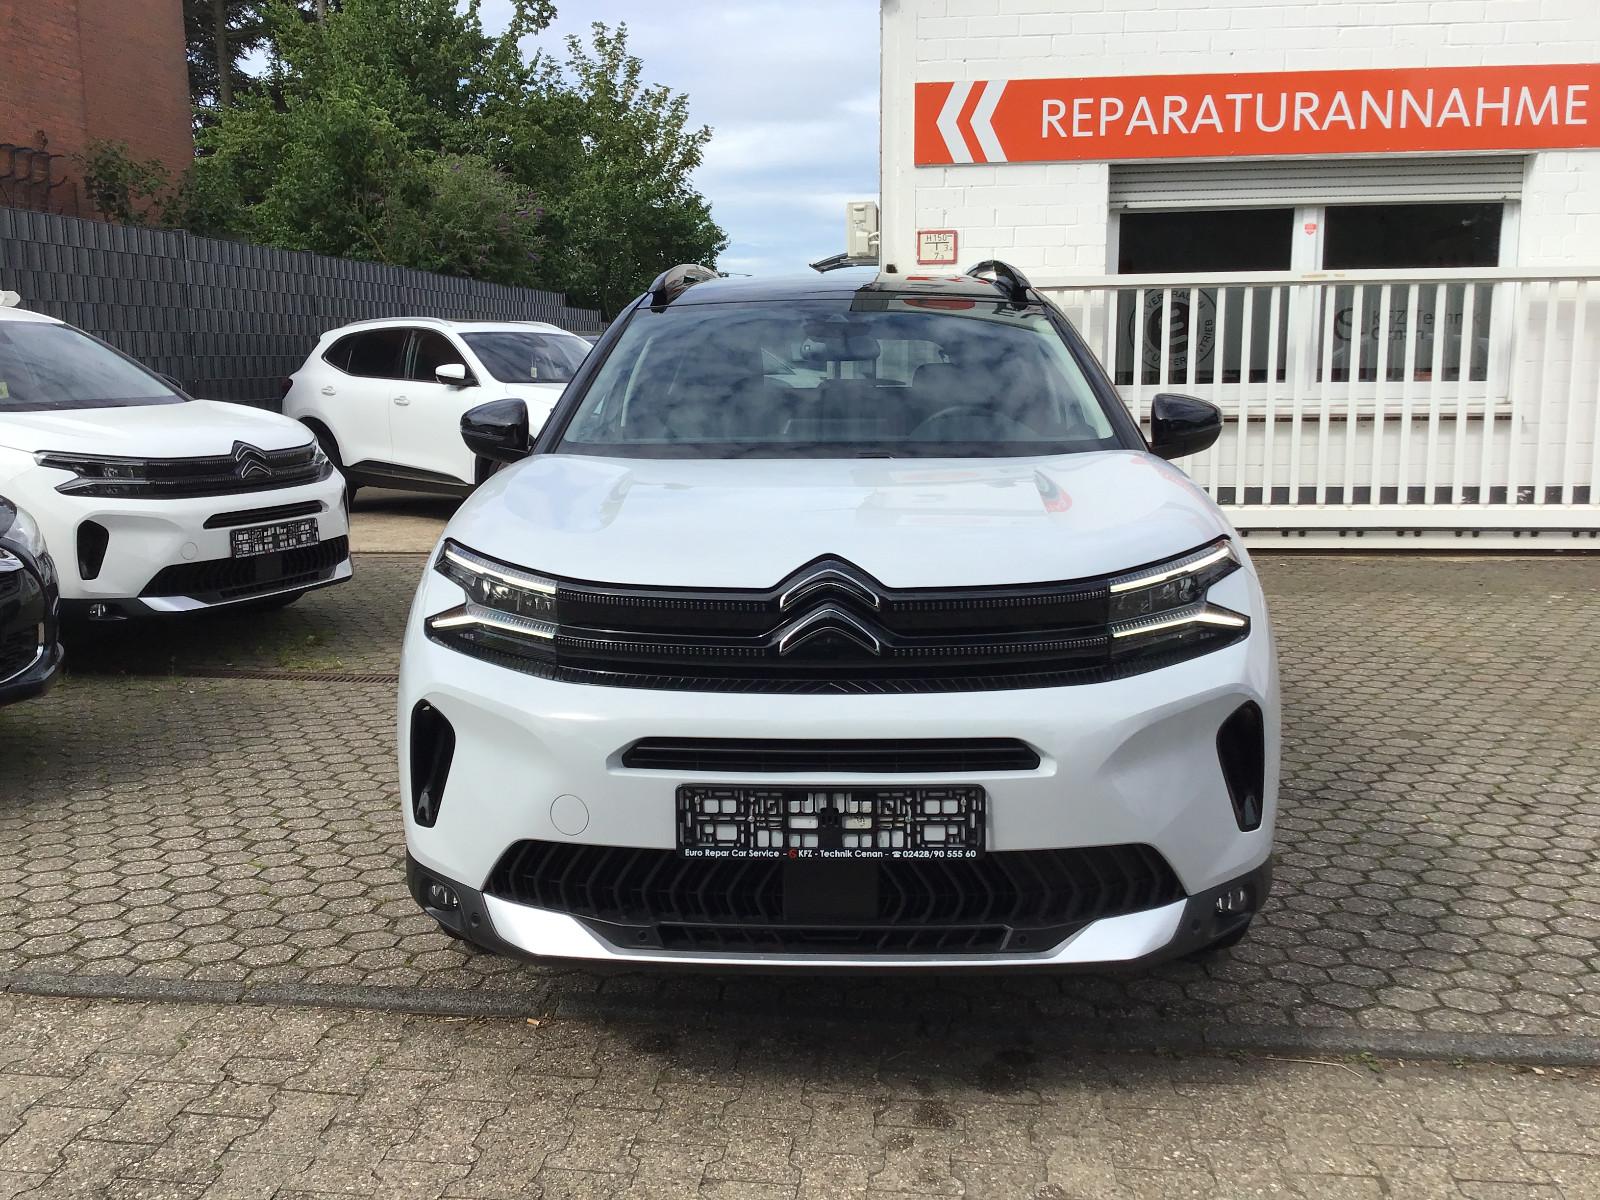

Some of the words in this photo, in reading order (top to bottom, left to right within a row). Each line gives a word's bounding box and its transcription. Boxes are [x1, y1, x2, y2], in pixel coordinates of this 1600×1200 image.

[1041, 85, 1590, 138] REPARATURANNAHME
[684, 848, 703, 858] Euro
[705, 848, 729, 859] Repar
[731, 849, 747, 858] Car
[748, 849, 780, 858] Service
[798, 849, 813, 858] KFZ
[820, 849, 853, 858] Technik
[854, 849, 883, 858] Cenan
[902, 849, 945, 858] 02428/90
[946, 849, 963, 858] 555
[965, 849, 977, 858] 60
